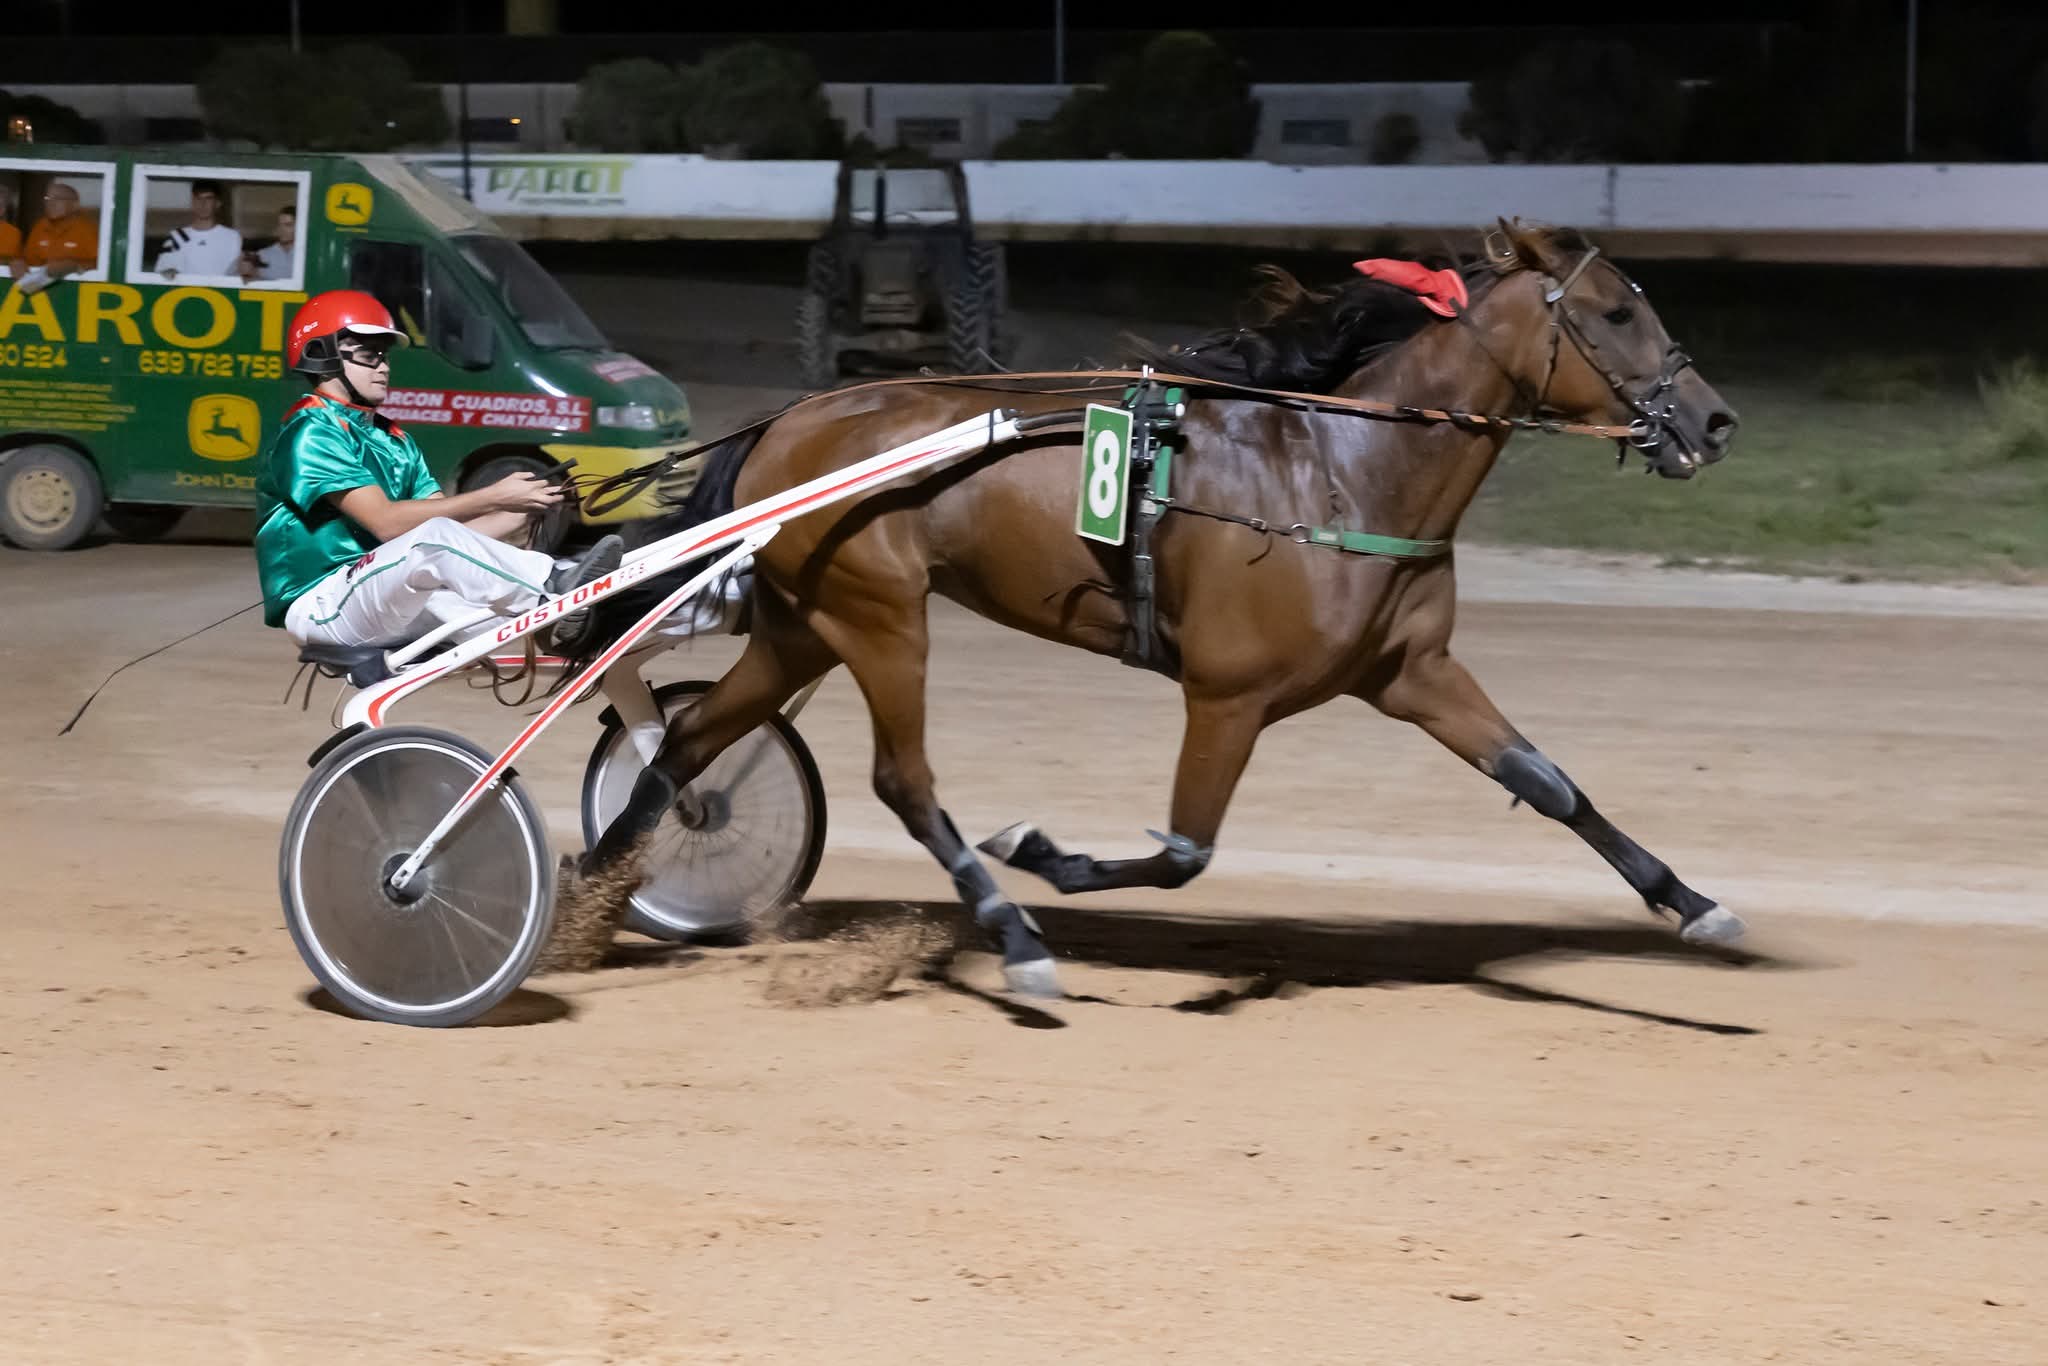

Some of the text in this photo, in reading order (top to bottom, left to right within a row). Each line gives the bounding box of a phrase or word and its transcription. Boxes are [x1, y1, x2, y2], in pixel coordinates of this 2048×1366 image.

[486, 160, 633, 196] PAROT
[23, 345, 67, 369] 524
[139, 350, 185, 375] 639
[188, 353, 234, 377] 782
[237, 355, 283, 379] 758
[451, 395, 550, 414] CUADROS,
[462, 412, 474, 423] Y
[481, 413, 582, 430] CHATARRAS
[1088, 429, 1121, 519] 8
[496, 576, 612, 643] CUSTOM
